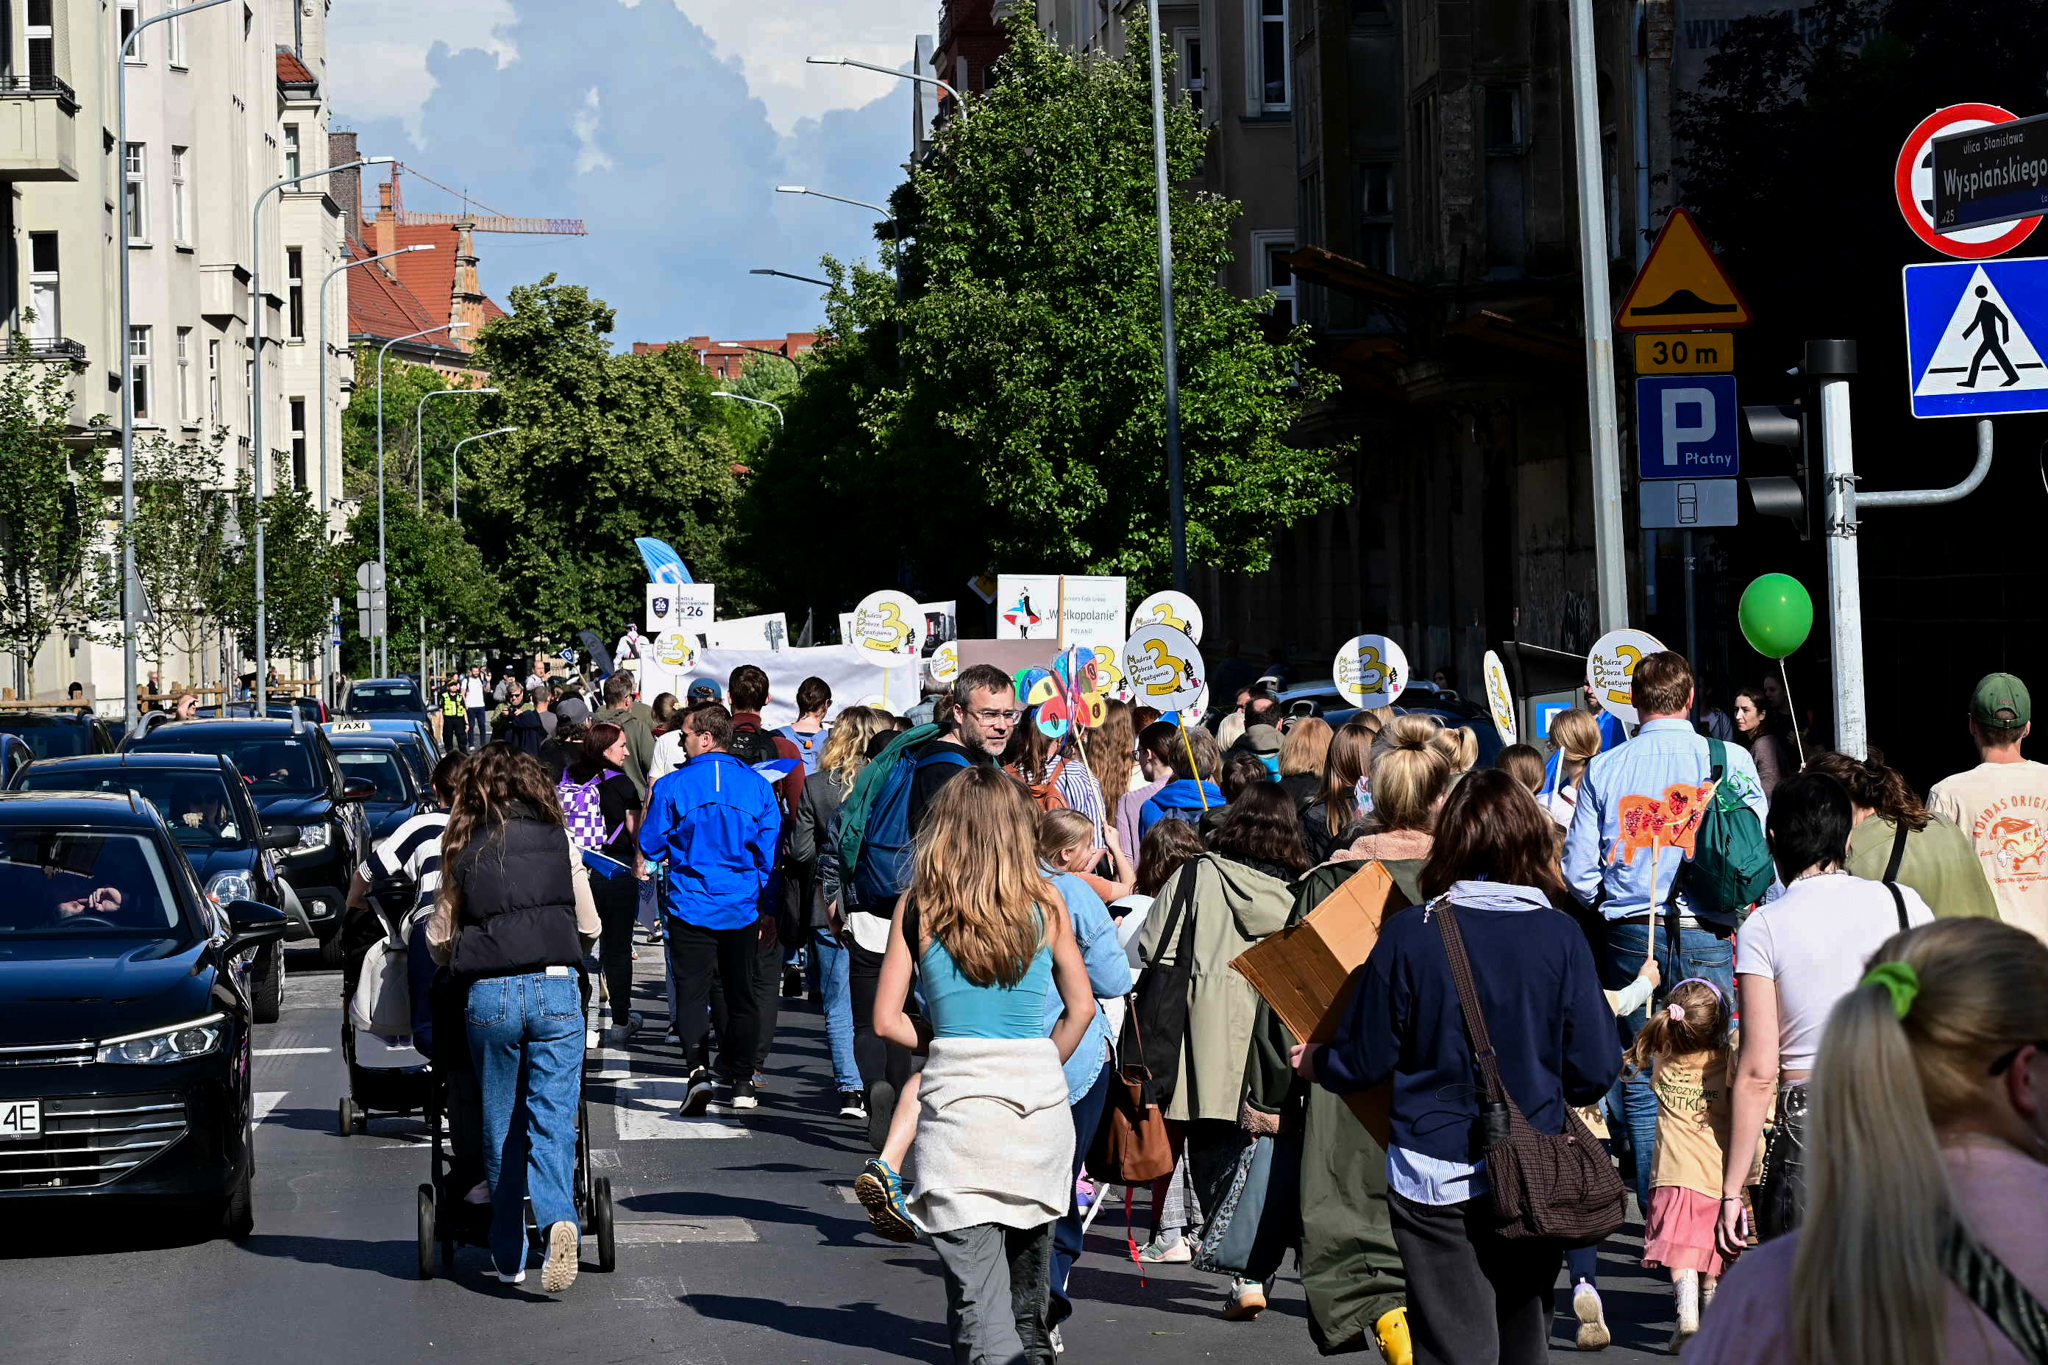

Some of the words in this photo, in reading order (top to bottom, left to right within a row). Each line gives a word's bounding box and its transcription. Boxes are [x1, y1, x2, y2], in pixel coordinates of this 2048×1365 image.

[1963, 141, 1980, 155] ulica
[1984, 131, 2024, 151] Stanisława
[1943, 155, 2048, 202] Wyspiańskiego
[1652, 341, 1688, 365] 30
[1695, 347, 1718, 364] m
[1661, 387, 1717, 466] P
[1685, 452, 1732, 467] Płatny
[686, 606, 703, 617] 26
[863, 602, 911, 651] 3
[1129, 664, 1154, 676] Dobrze
[1133, 670, 1170, 687] Kreatywnie
[1143, 638, 1187, 695] 3
[1348, 646, 1393, 694] 3
[1593, 665, 1621, 676] Dobrze
[338, 722, 365, 730] TAXI
[2011, 795, 2048, 811] ORIGI
[3, 1104, 36, 1131] 4E
